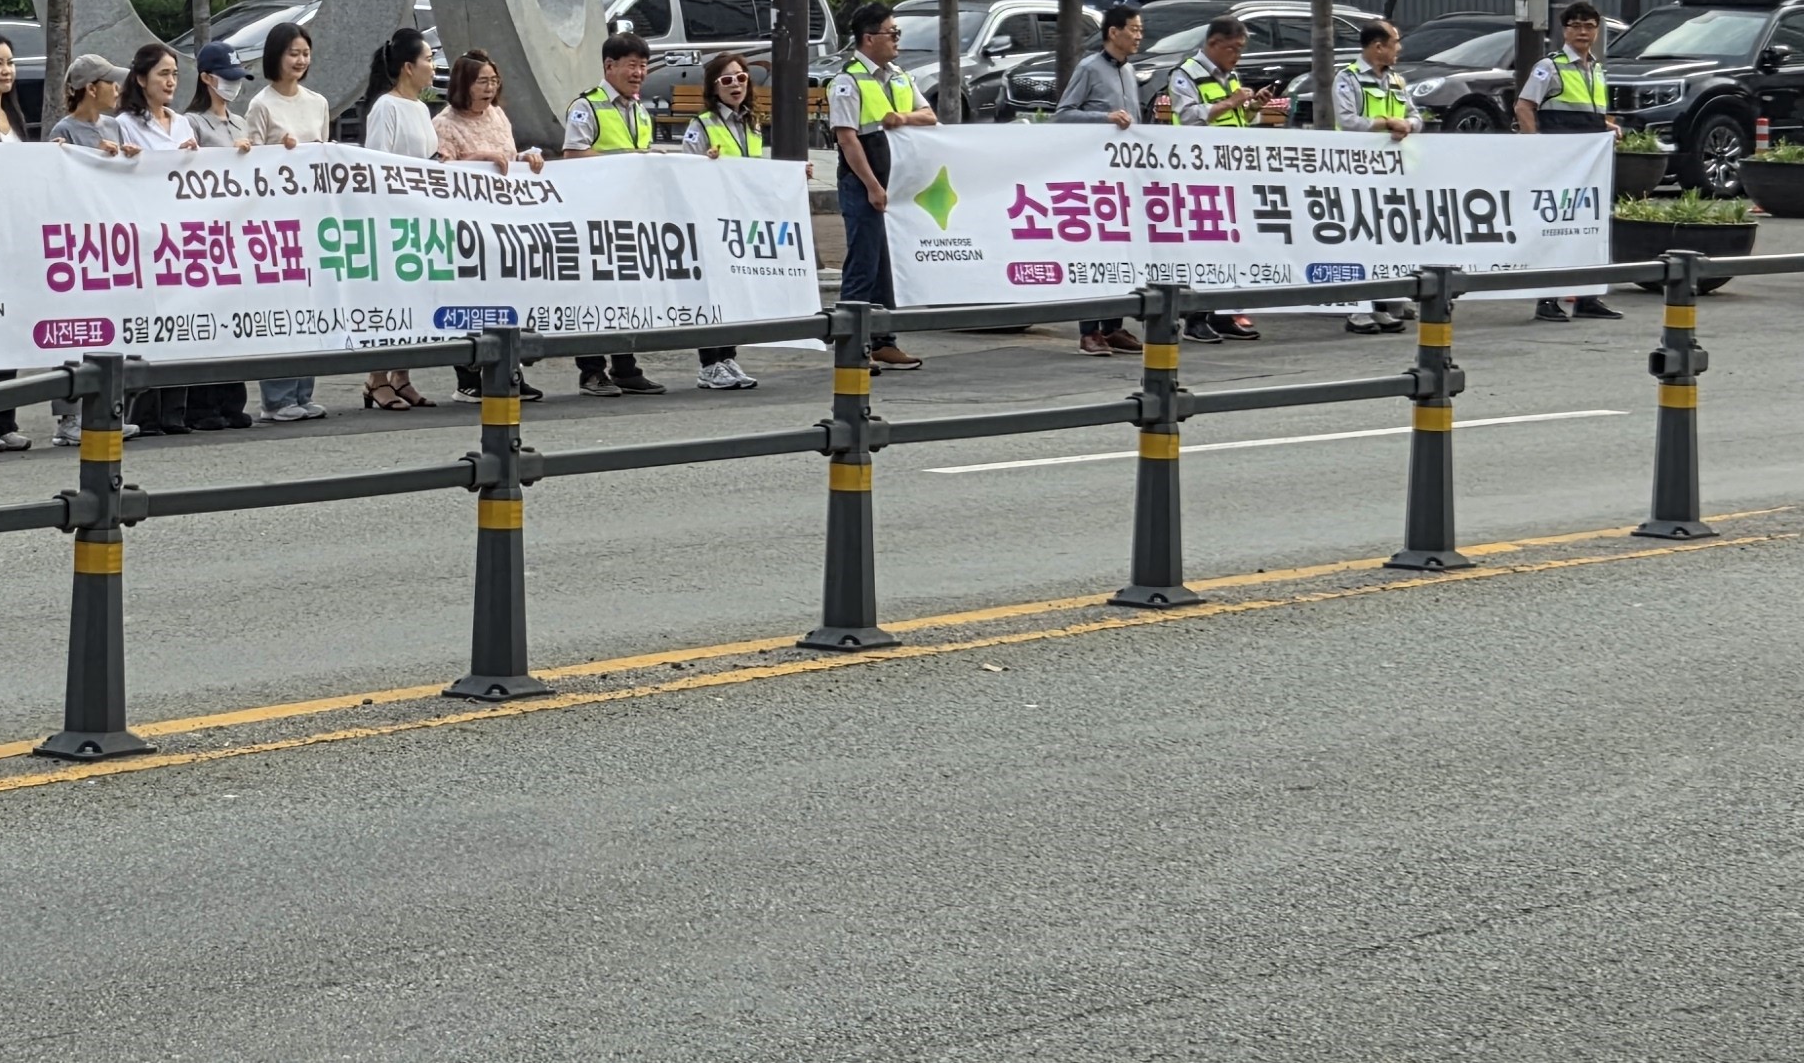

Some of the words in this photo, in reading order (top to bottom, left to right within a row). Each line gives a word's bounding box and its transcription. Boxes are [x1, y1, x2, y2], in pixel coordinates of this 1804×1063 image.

[1213, 144, 1261, 173] 제9회
[1266, 146, 1405, 176] 전국동시지방선거
[311, 162, 377, 196] 제9회
[383, 163, 563, 206] 전국동시지방선거
[1007, 180, 1132, 243] 소중한
[1142, 181, 1241, 244] 한표!
[1252, 184, 1293, 245] 꼭
[1304, 184, 1518, 245] 행사하세요!
[920, 239, 932, 248] MY
[933, 238, 972, 248] UNIVERSE
[1583, 227, 1600, 235] CITY
[42, 222, 144, 293] 당신의
[153, 219, 242, 288] 소중한
[319, 216, 380, 282] 우리
[390, 216, 487, 282] 경산의
[491, 220, 580, 282] 미래를
[587, 219, 703, 282] 만들어요!
[915, 249, 984, 263] GYEONGSAN
[730, 265, 785, 277] GYEONGSAN
[788, 267, 807, 278] CITY
[1013, 265, 1057, 283] 사전투표
[1068, 263, 1088, 284] 5월
[1090, 262, 1136, 284] 29일(금)
[1195, 263, 1237, 284] 오전6시
[1249, 262, 1292, 285] 오후6시
[1311, 265, 1362, 283] 선거일투표
[42, 320, 104, 345] 사전투표
[122, 317, 150, 344] 5월
[154, 312, 218, 343] 29일(금)
[231, 309, 293, 339] 30일(토)
[526, 306, 551, 331] 6월
[553, 305, 601, 332] 3일(수)
